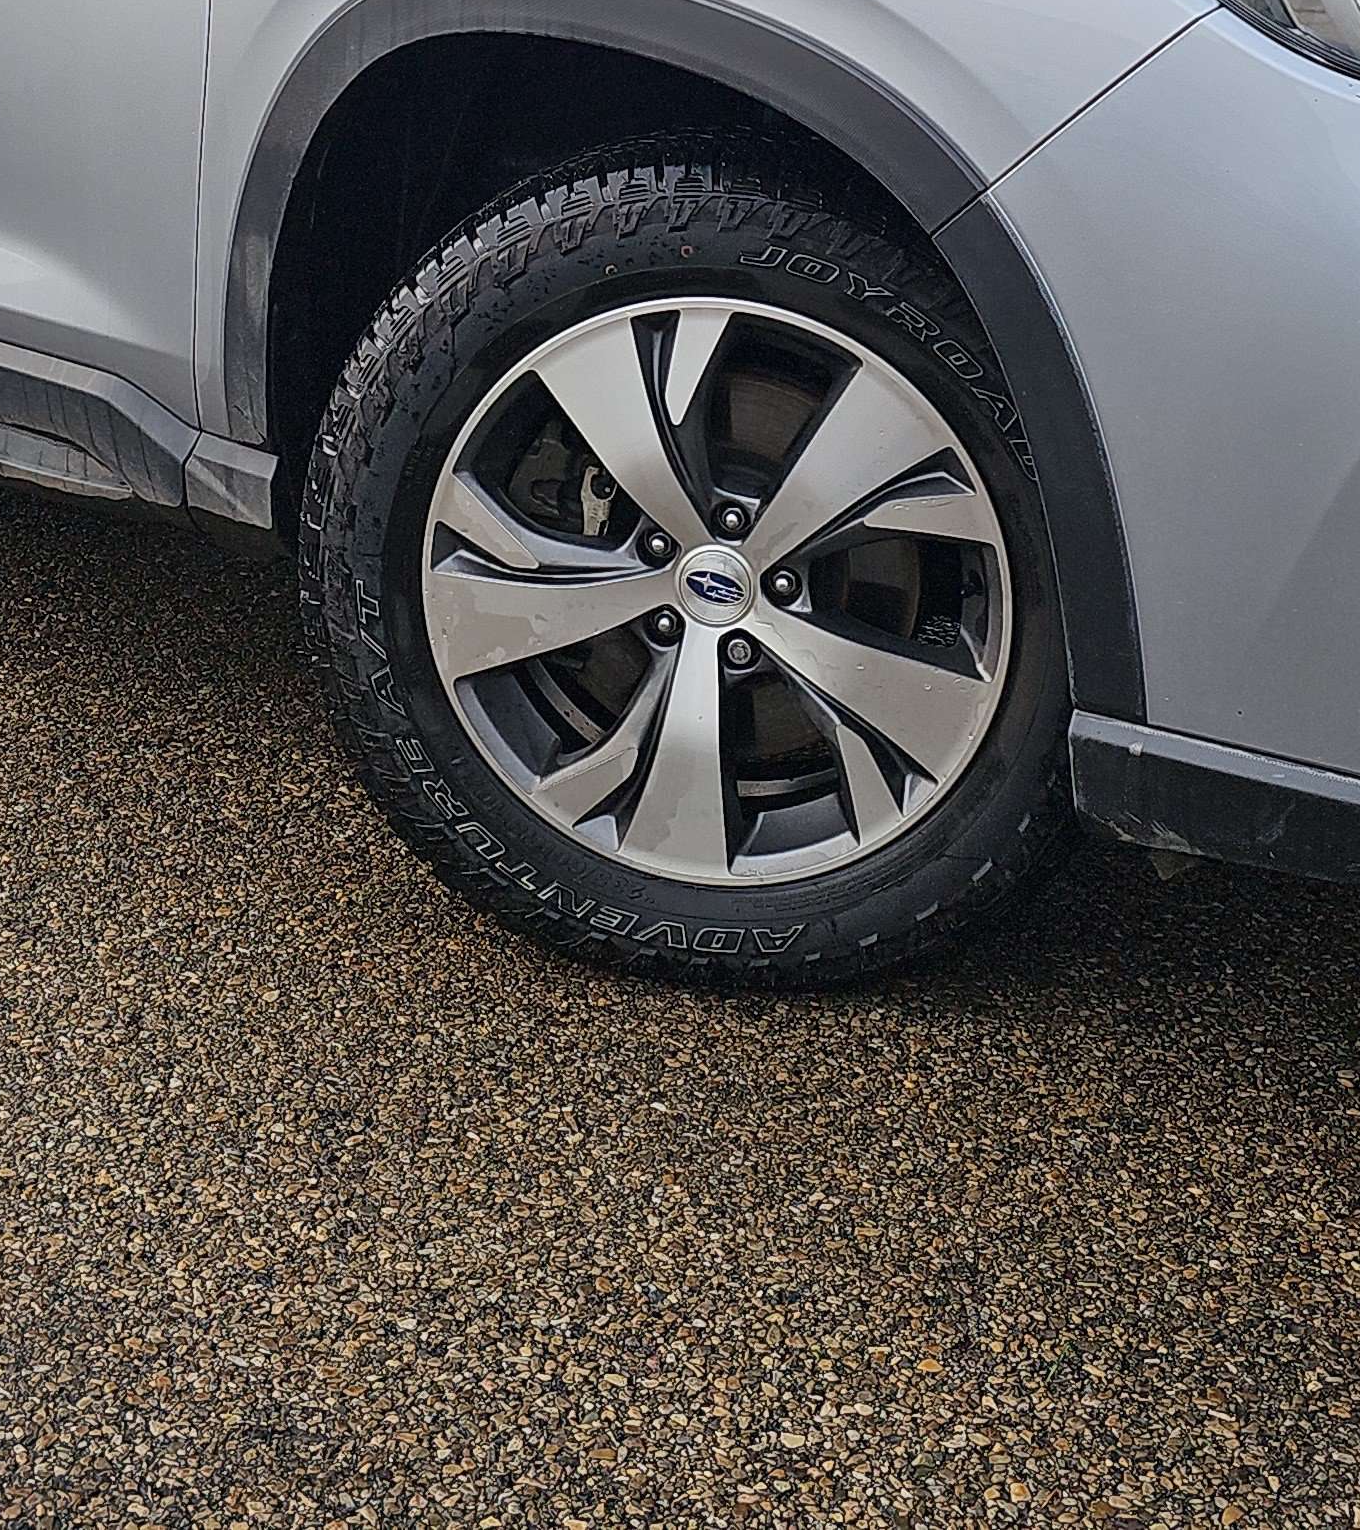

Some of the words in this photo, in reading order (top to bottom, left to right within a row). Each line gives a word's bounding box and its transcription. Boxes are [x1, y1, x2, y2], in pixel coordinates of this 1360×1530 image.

[740, 246, 1038, 481] JOYROAD
[356, 580, 407, 717] A/T
[396, 737, 807, 953] ADVENTURE
